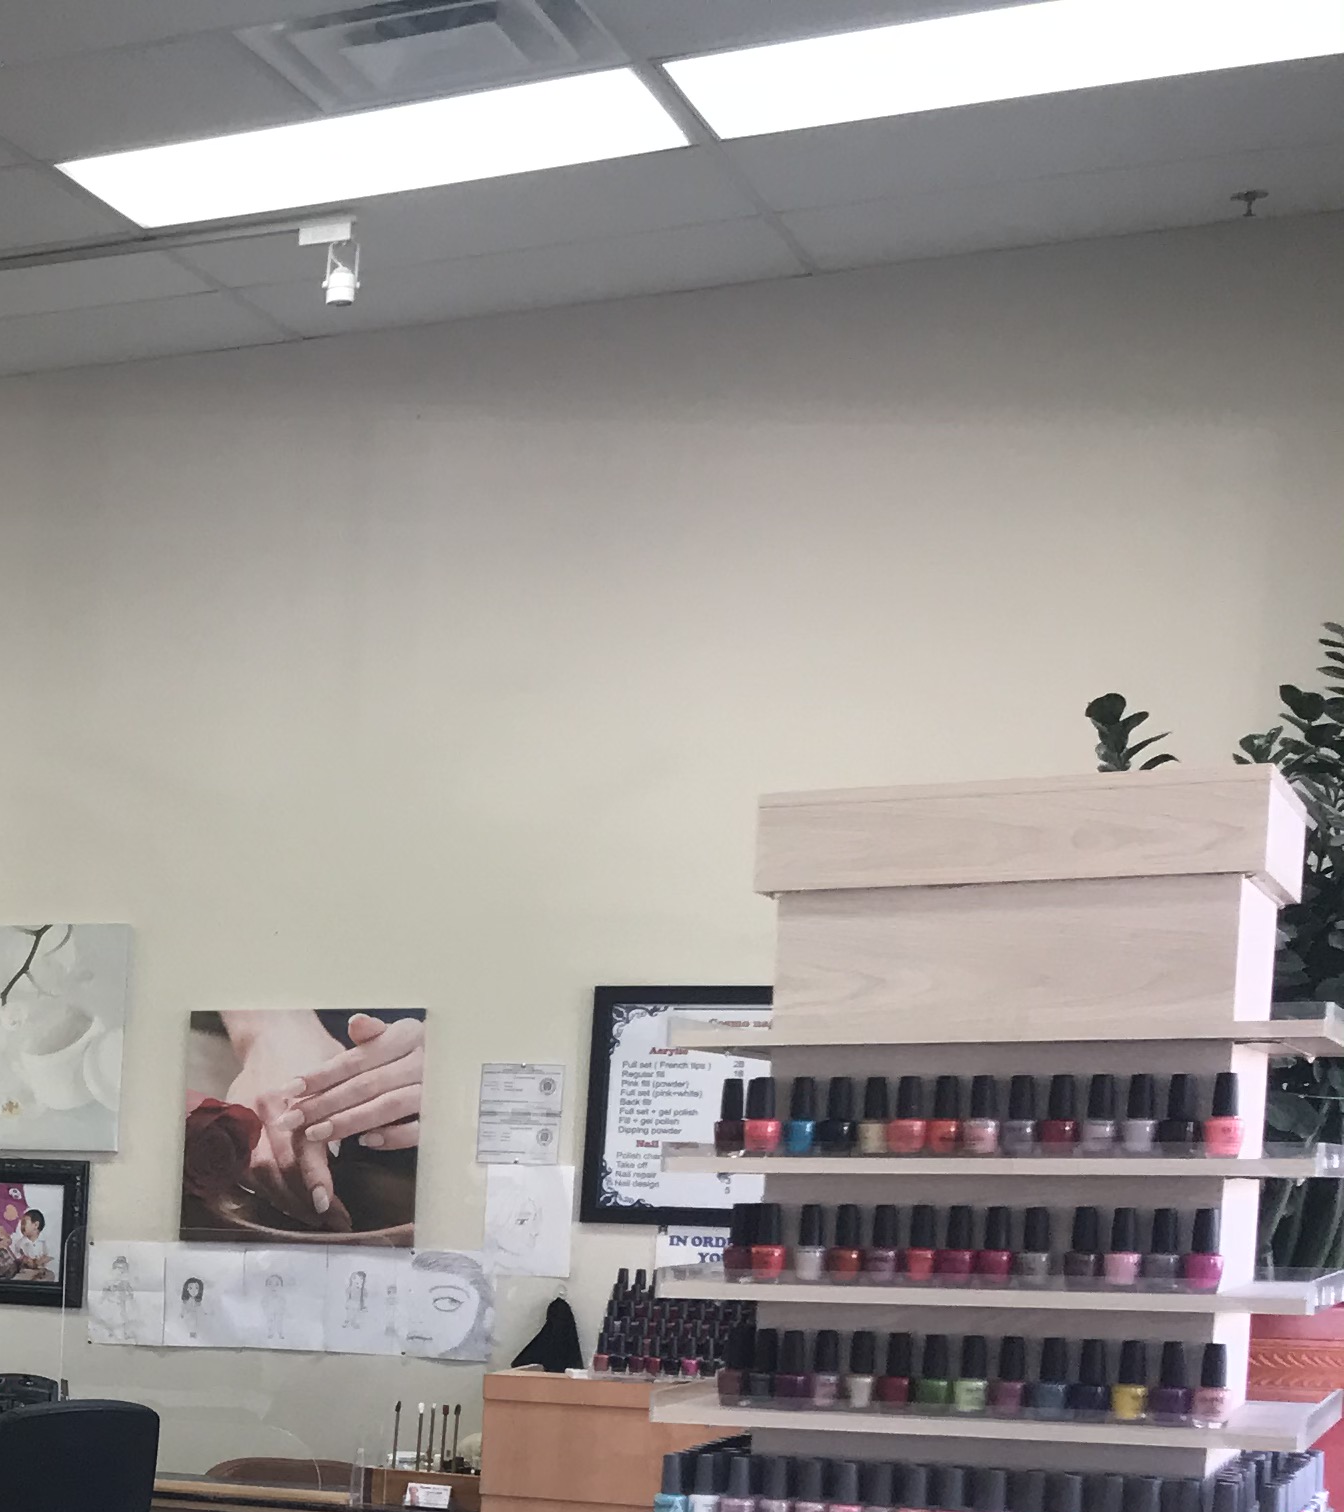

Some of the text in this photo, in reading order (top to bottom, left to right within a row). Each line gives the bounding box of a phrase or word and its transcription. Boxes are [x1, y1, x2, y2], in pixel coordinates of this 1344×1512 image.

[659, 1061, 688, 1069] French
[621, 1071, 654, 1079] Regular
[619, 1107, 635, 1115] Full
[658, 1109, 672, 1117] gel
[640, 1118, 653, 1126] gel
[654, 1118, 680, 1126] polish
[618, 1126, 682, 1135] Dipping powder
[616, 1151, 641, 1160] Polish
[616, 1161, 635, 1169] Take
[632, 1180, 659, 1189] design
[669, 1235, 689, 1246] IN
[698, 1252, 723, 1263] YO
